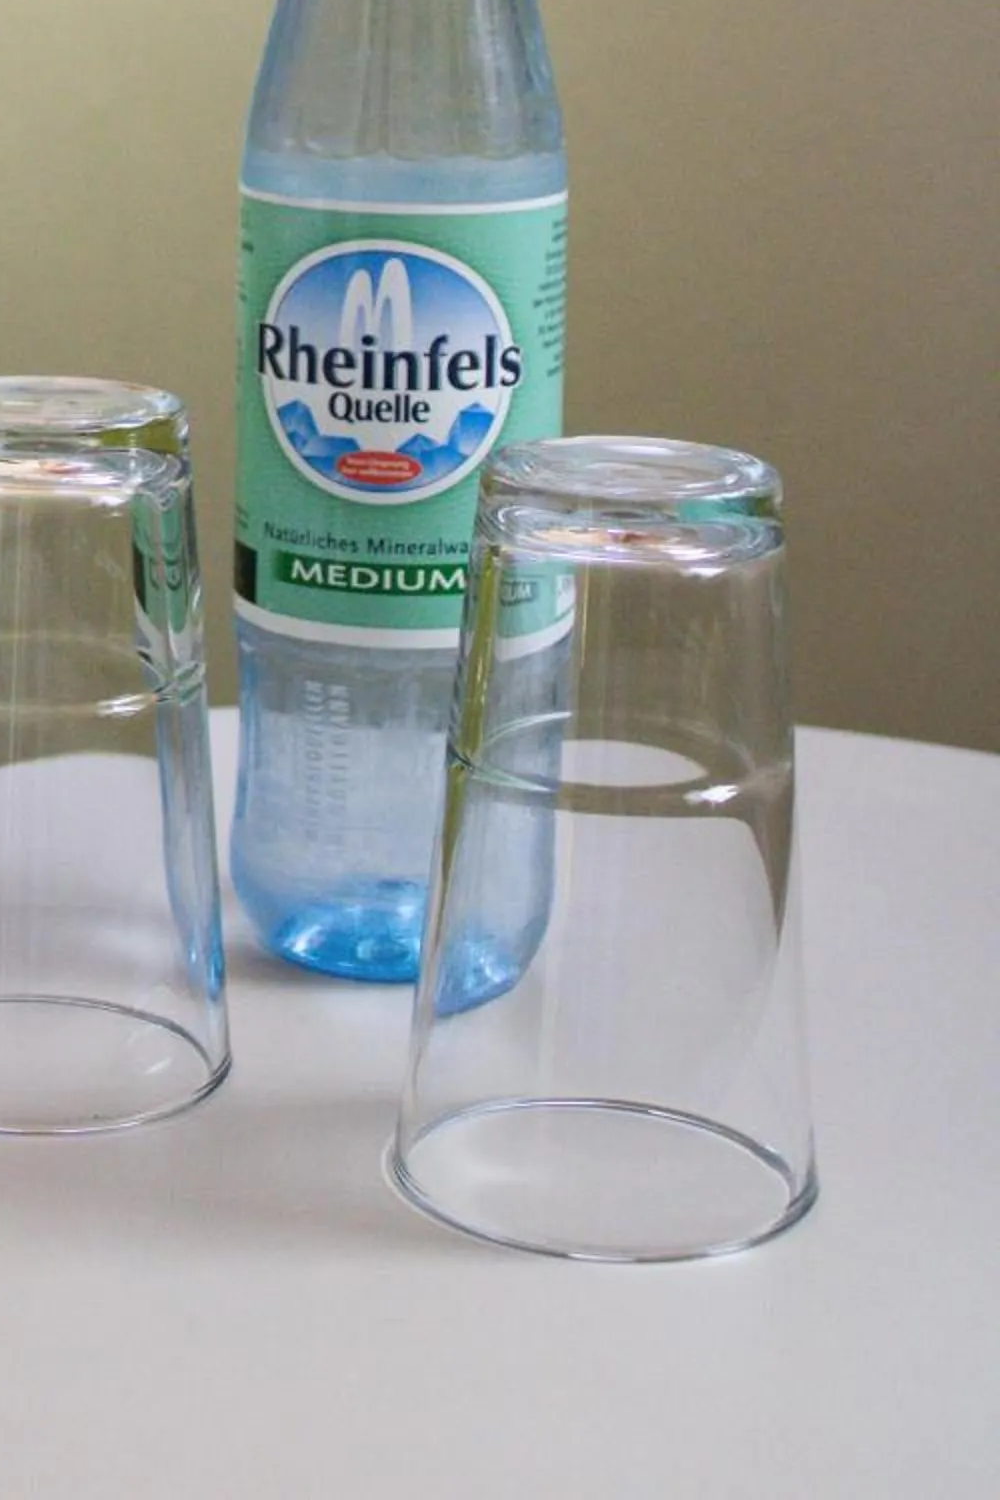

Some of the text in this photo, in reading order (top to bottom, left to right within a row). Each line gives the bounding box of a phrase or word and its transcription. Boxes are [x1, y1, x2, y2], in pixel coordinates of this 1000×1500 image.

[258, 323, 521, 391] Rheinfels
[328, 391, 431, 423] Quelle
[264, 520, 469, 556] Natürliches Mineralwa
[291, 559, 467, 591] MEDIUM
